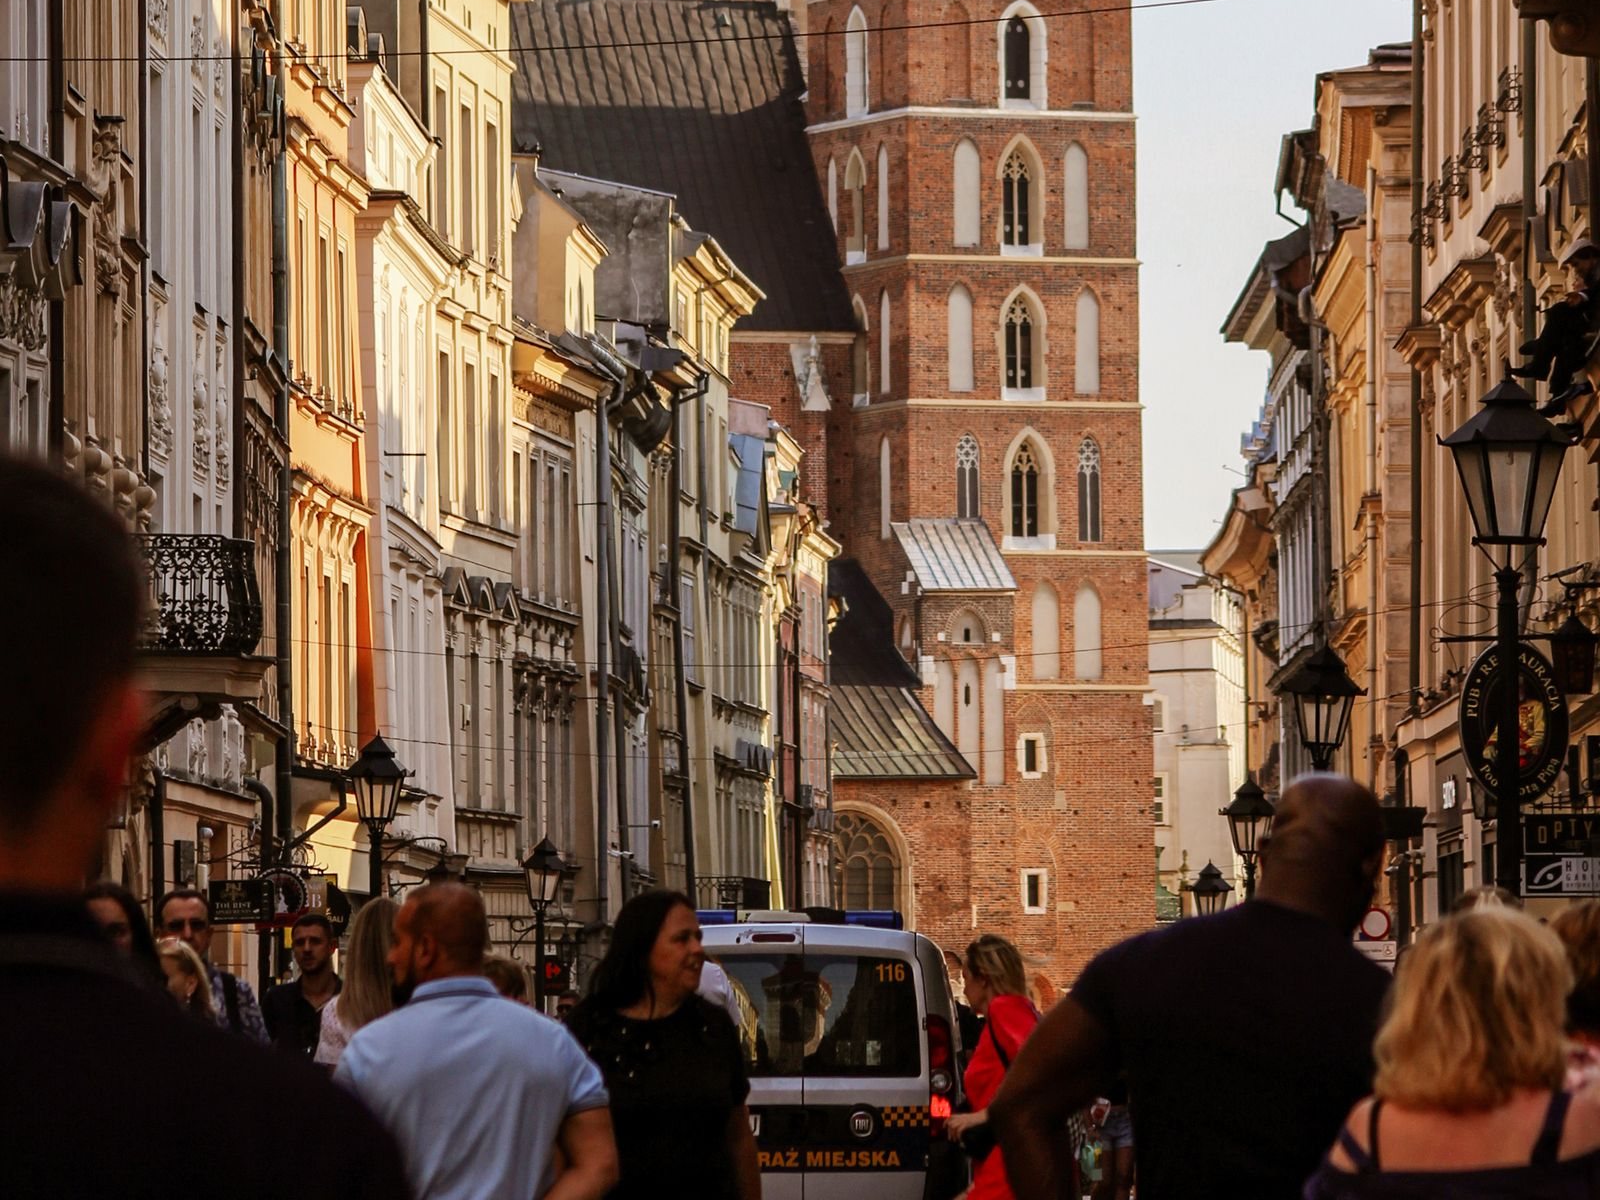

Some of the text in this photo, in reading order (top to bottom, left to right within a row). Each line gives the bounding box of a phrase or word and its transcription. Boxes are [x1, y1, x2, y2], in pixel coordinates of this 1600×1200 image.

[1467, 652, 1561, 717] PUB REAURACJA
[1565, 860, 1600, 873] HO
[215, 901, 251, 909] TOURIST
[875, 963, 905, 982] 116
[855, 1118, 870, 1131] FIAT
[757, 1147, 901, 1168] RAŻ MIEJSKA
